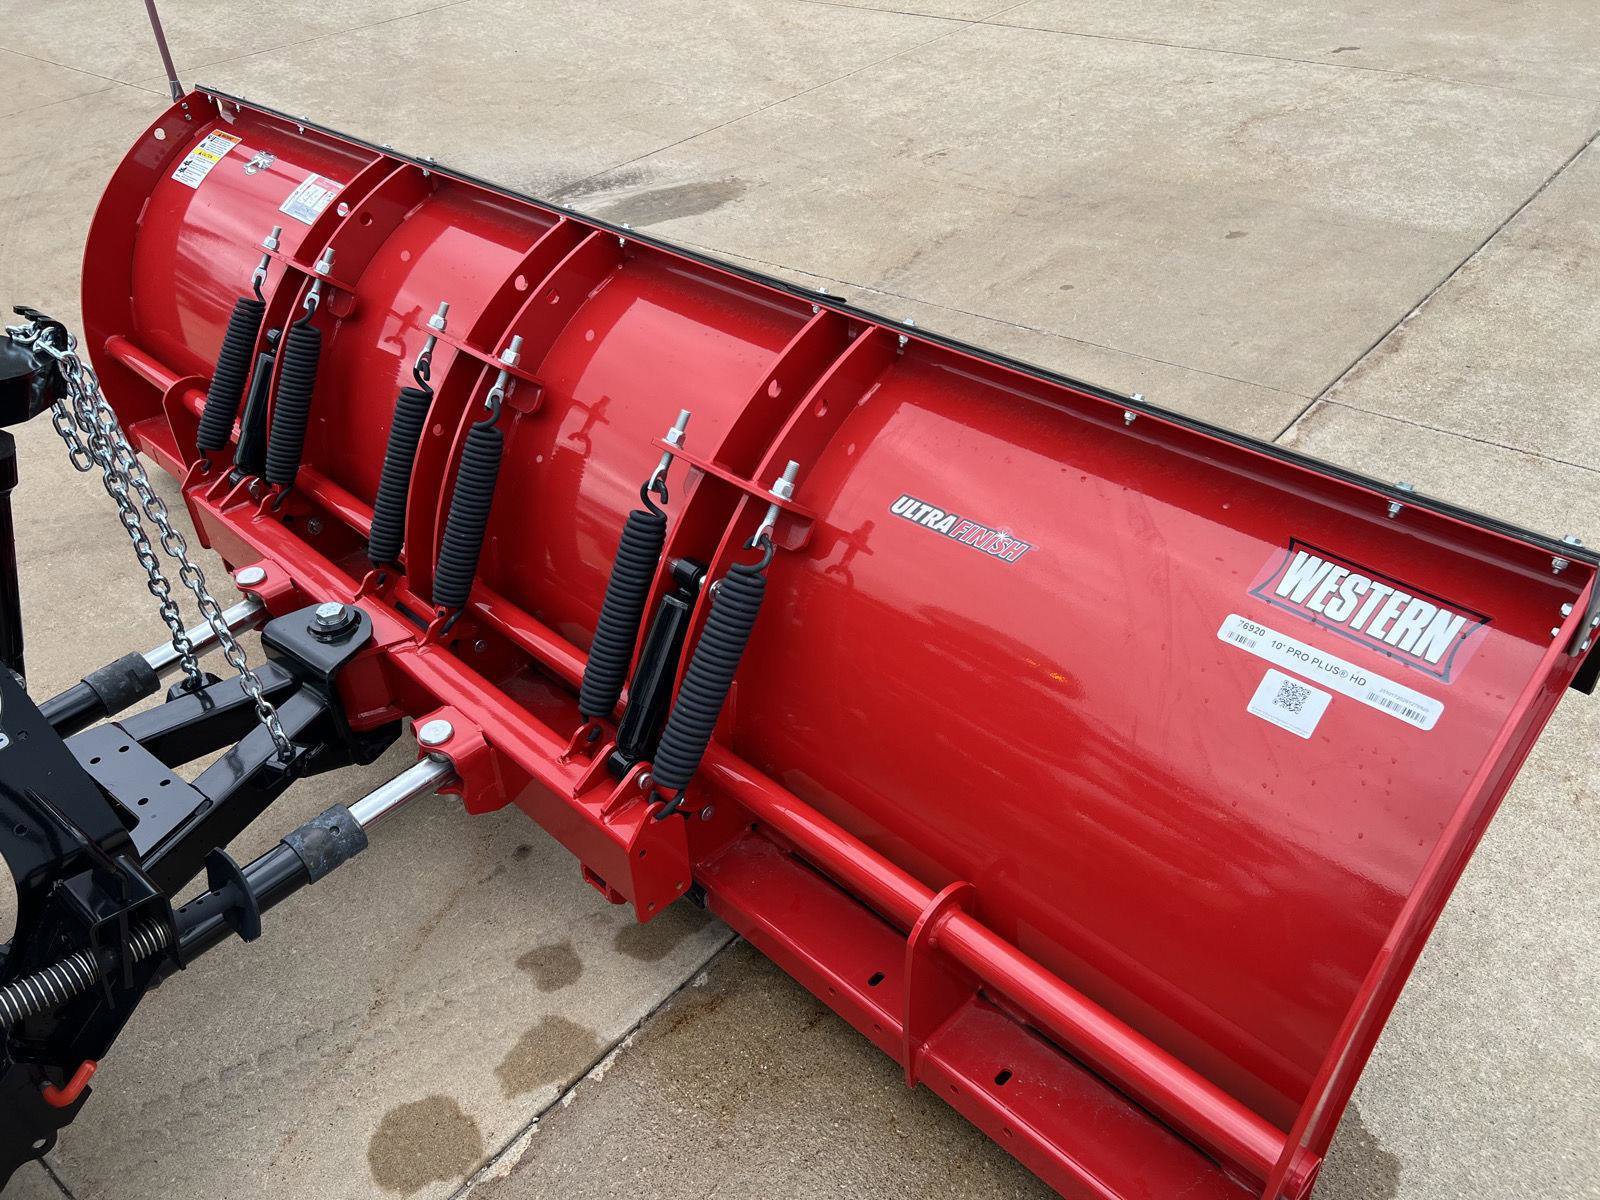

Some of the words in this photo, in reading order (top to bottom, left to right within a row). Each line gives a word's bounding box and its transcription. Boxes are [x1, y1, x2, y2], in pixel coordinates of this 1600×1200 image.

[891, 495, 957, 534] ULTRA
[950, 519, 1029, 562] FINISH
[1274, 550, 1467, 664] WESTERN
[1286, 646, 1310, 662] PRO
[1350, 673, 1367, 687] HD
